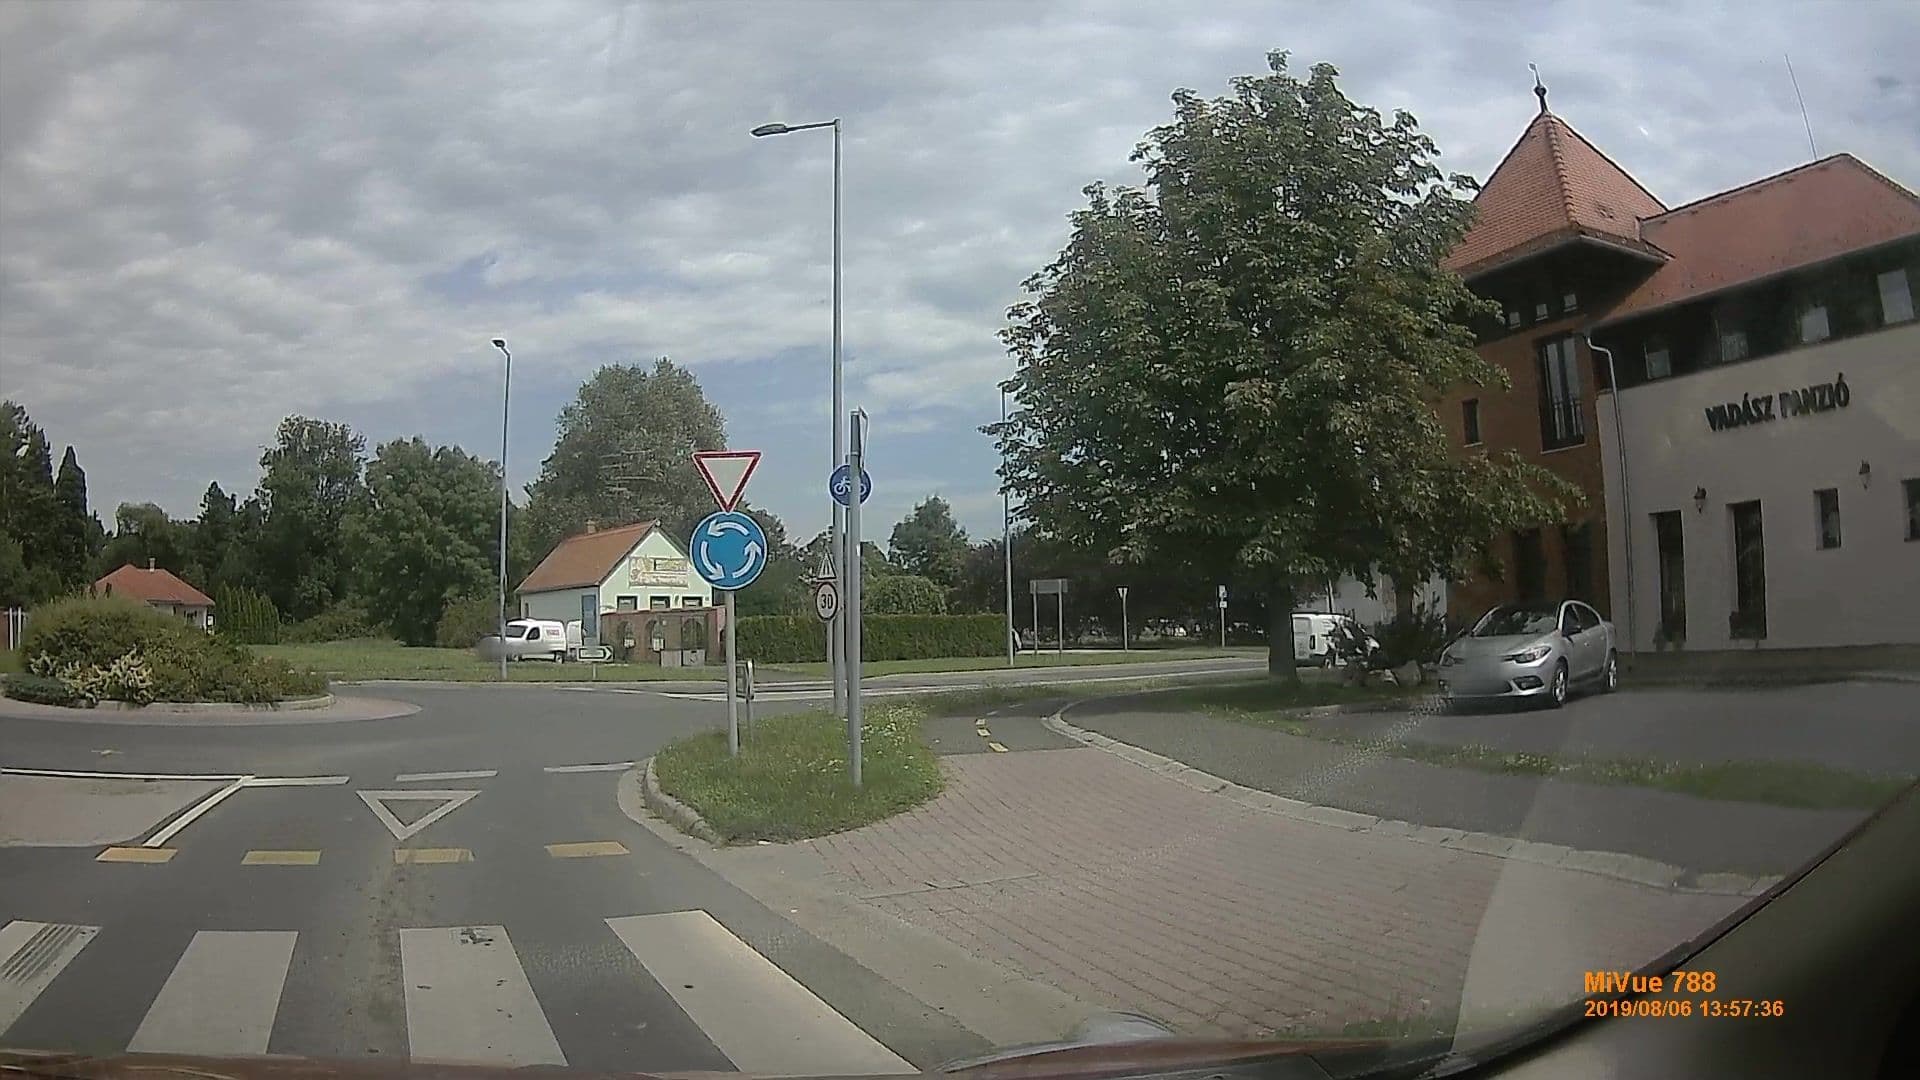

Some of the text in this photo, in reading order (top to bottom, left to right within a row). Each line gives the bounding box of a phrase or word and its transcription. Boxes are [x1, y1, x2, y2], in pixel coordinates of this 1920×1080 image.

[1705, 372, 1850, 431] VADÁSZ PANZIÓ
[821, 594, 833, 609] 30
